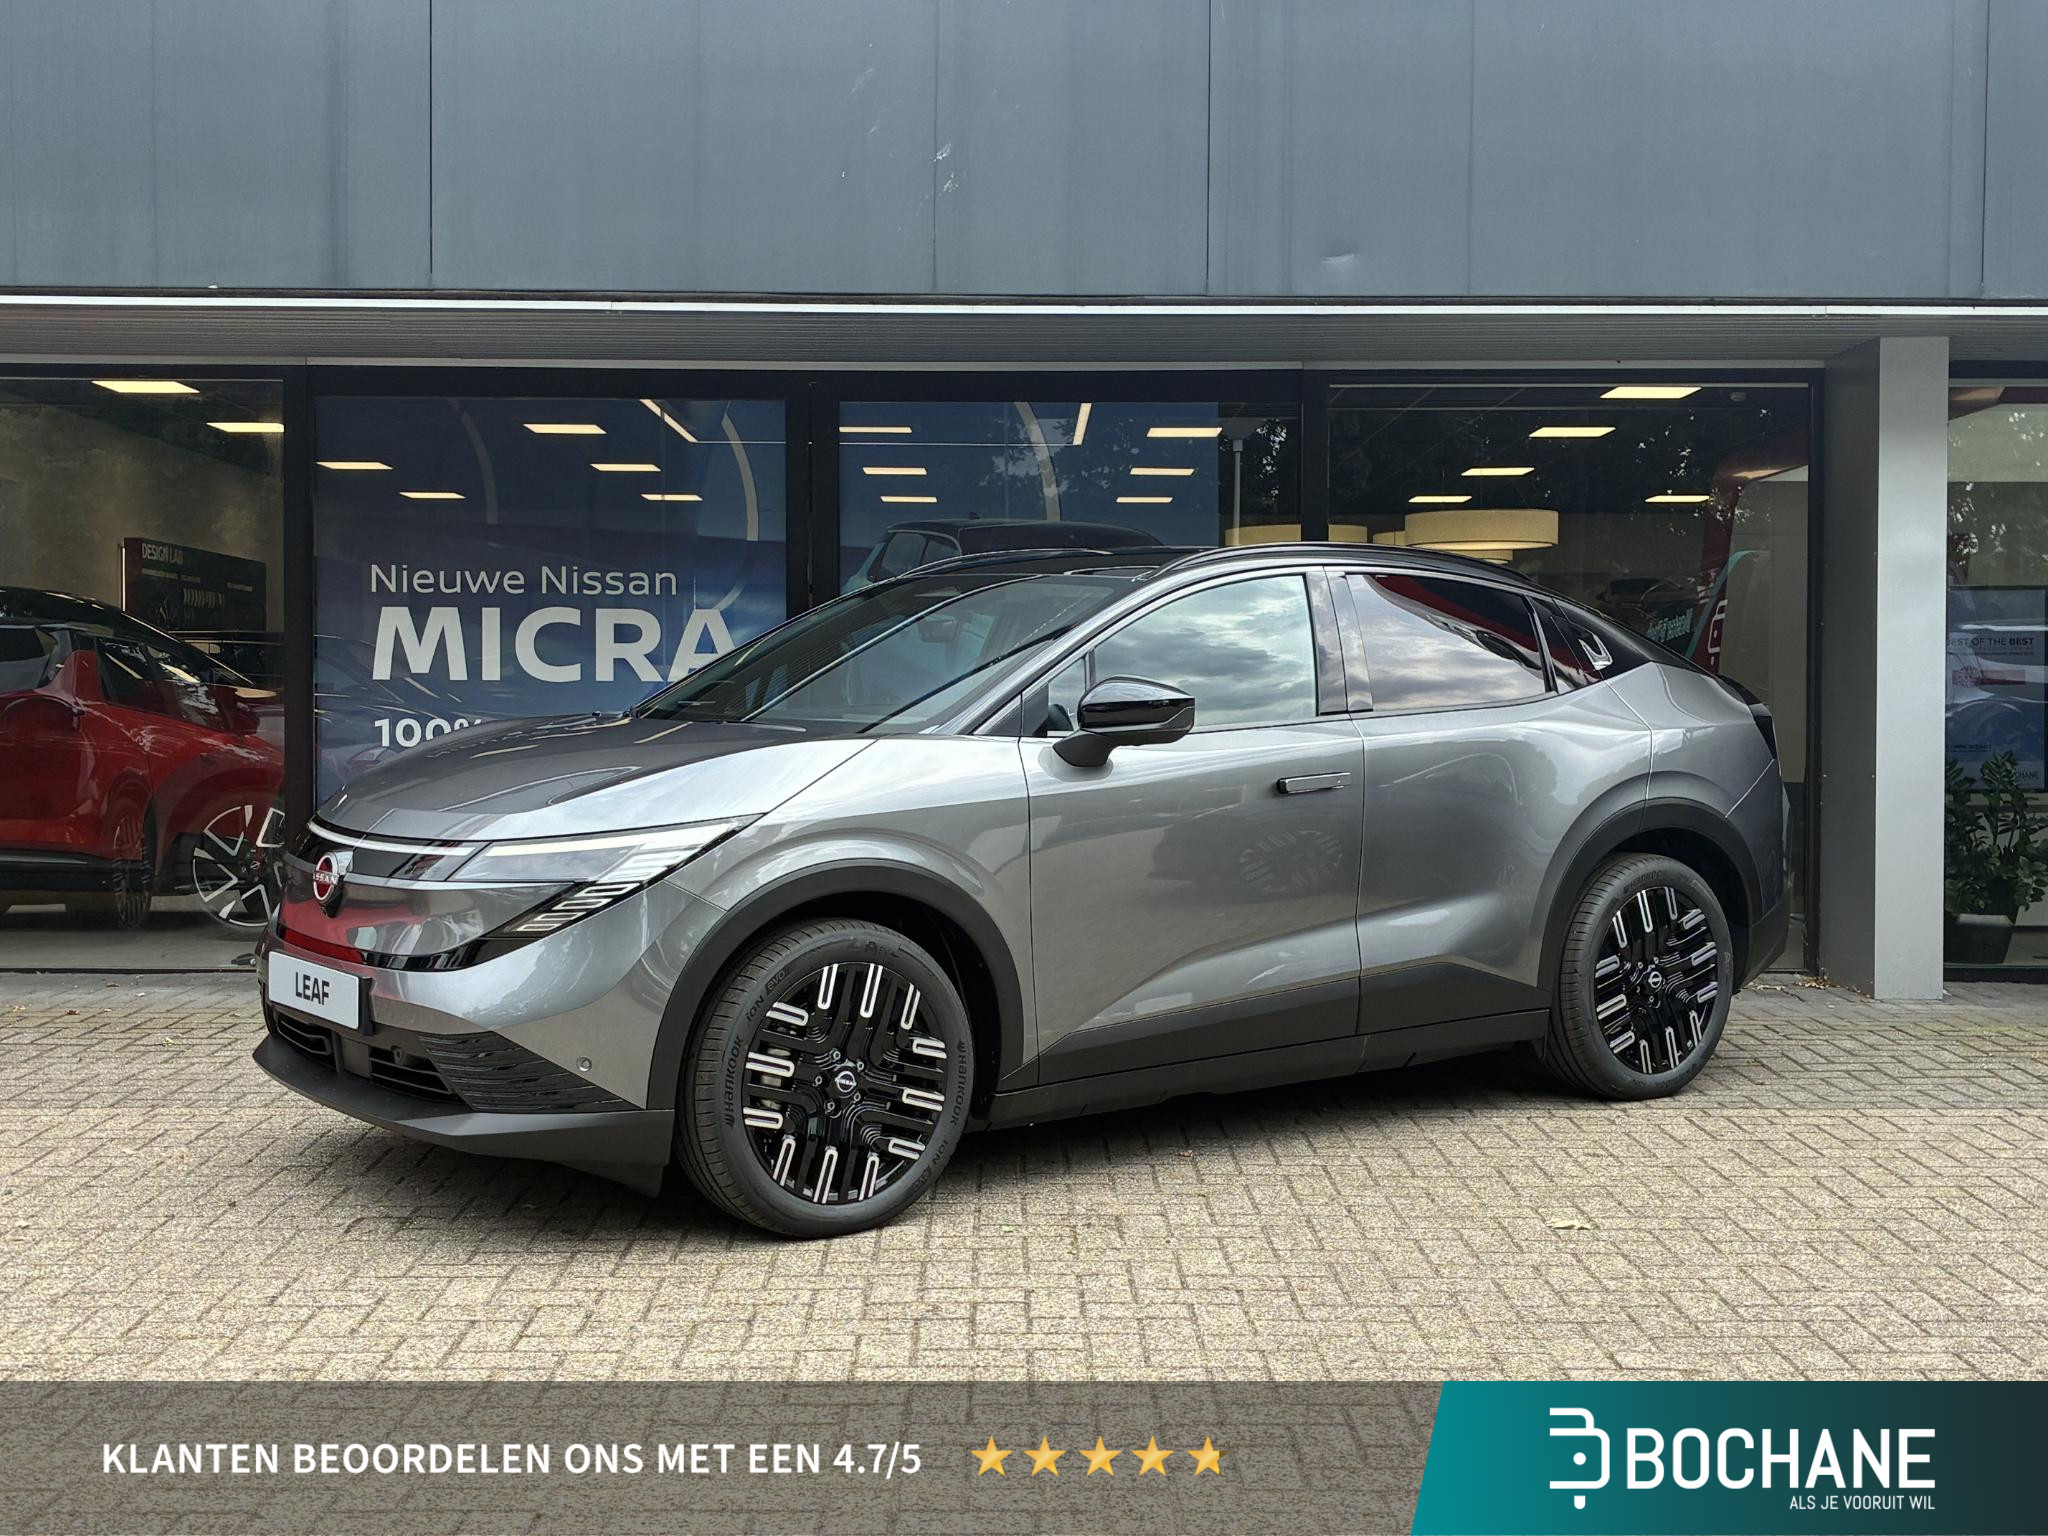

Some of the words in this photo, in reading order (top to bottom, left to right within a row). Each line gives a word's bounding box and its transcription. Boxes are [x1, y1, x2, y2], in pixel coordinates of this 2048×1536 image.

[141, 543, 169, 562] DESIGN
[370, 564, 526, 594] Nieuwe
[541, 565, 677, 596] Nissan
[372, 606, 739, 683] MICRA
[1971, 637, 1985, 646] OF
[1988, 637, 2007, 646] THE
[295, 971, 330, 1006] LEAF
